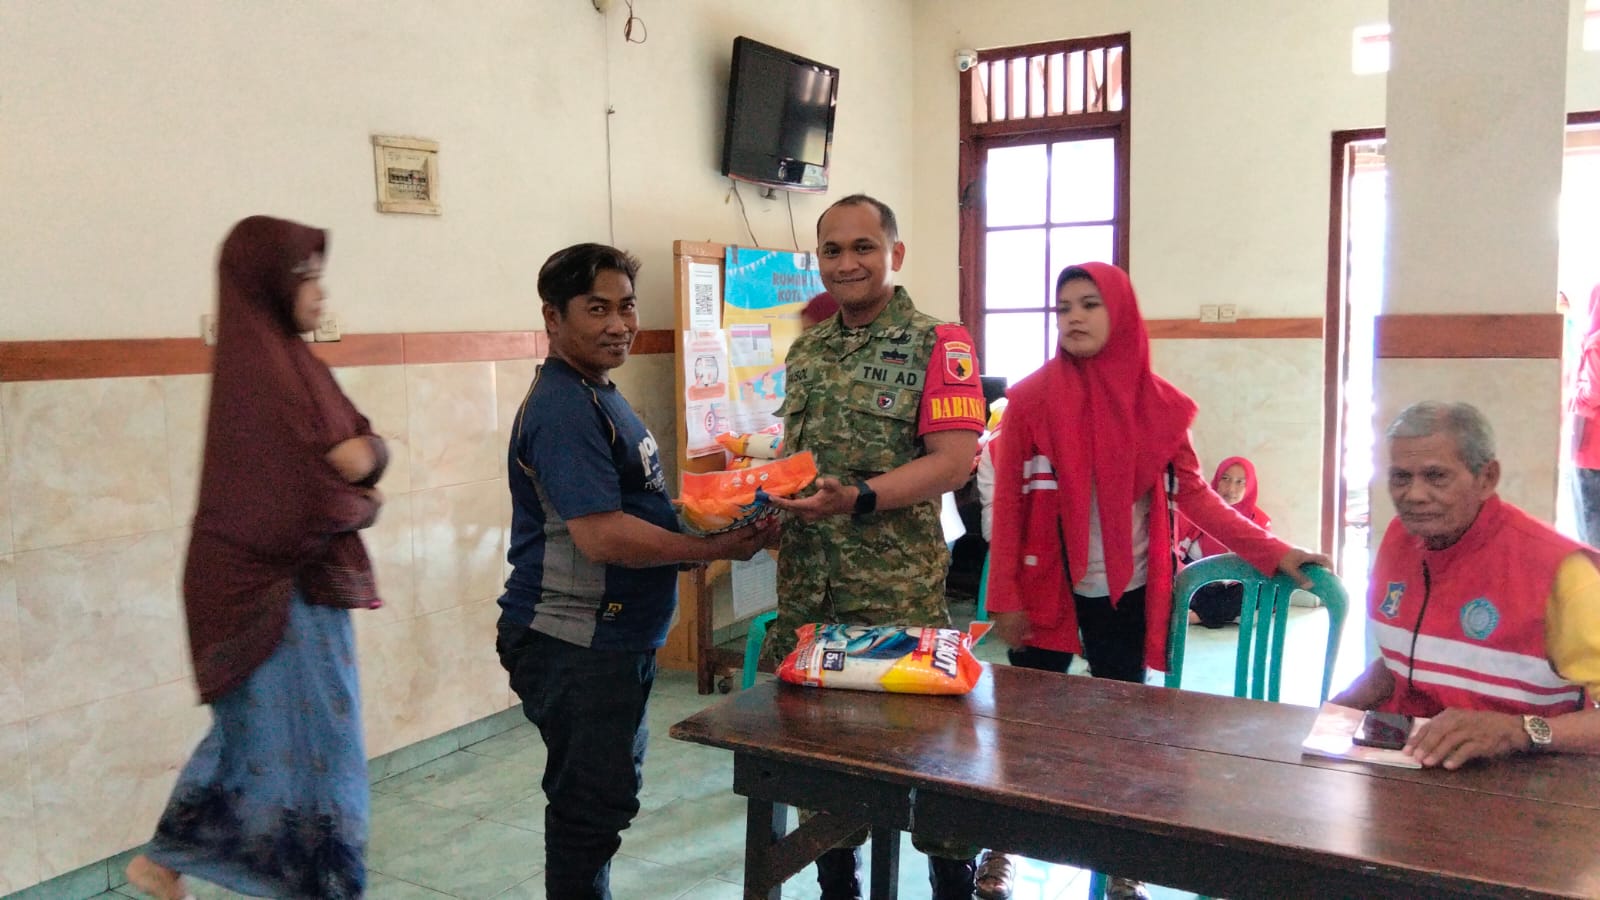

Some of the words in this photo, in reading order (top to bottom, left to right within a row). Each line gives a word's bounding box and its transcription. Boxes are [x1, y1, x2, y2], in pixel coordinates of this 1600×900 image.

[772, 272, 807, 287] RUMAH
[863, 366, 888, 381] TNI
[895, 371, 917, 386] AD
